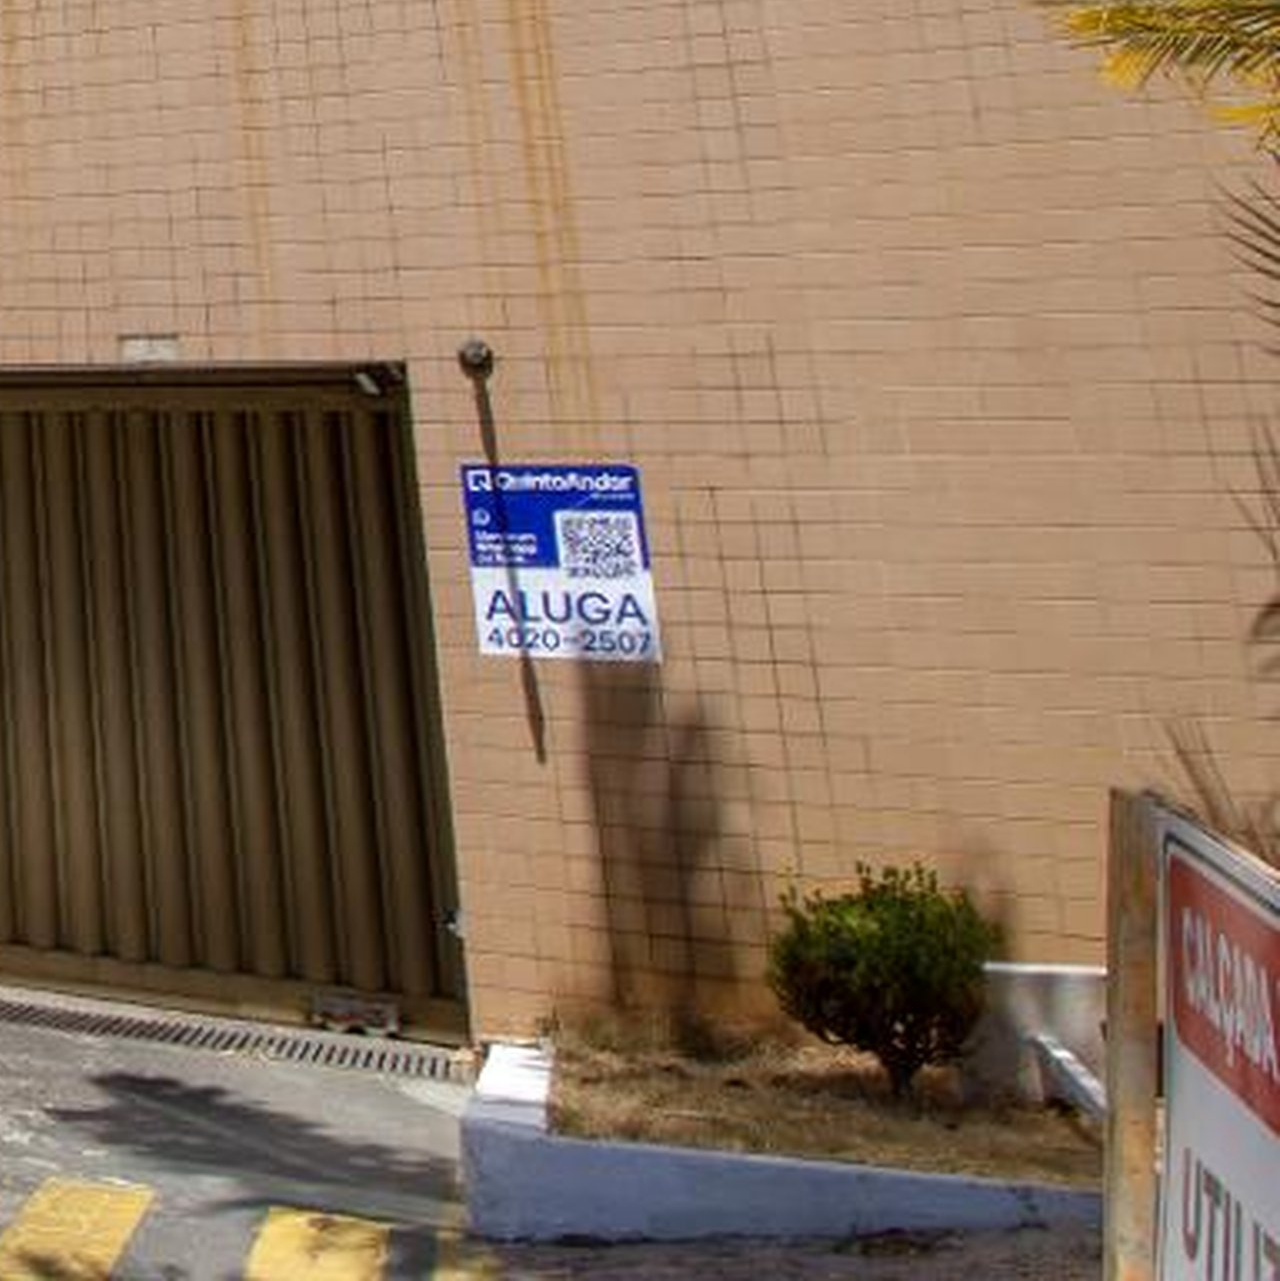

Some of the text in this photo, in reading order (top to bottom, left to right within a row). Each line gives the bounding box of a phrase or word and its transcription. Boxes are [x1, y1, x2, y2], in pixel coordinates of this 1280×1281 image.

[496, 472, 634, 492] QuintoAndar
[487, 590, 648, 626] ALUGA
[488, 628, 651, 654] 4020-2507
